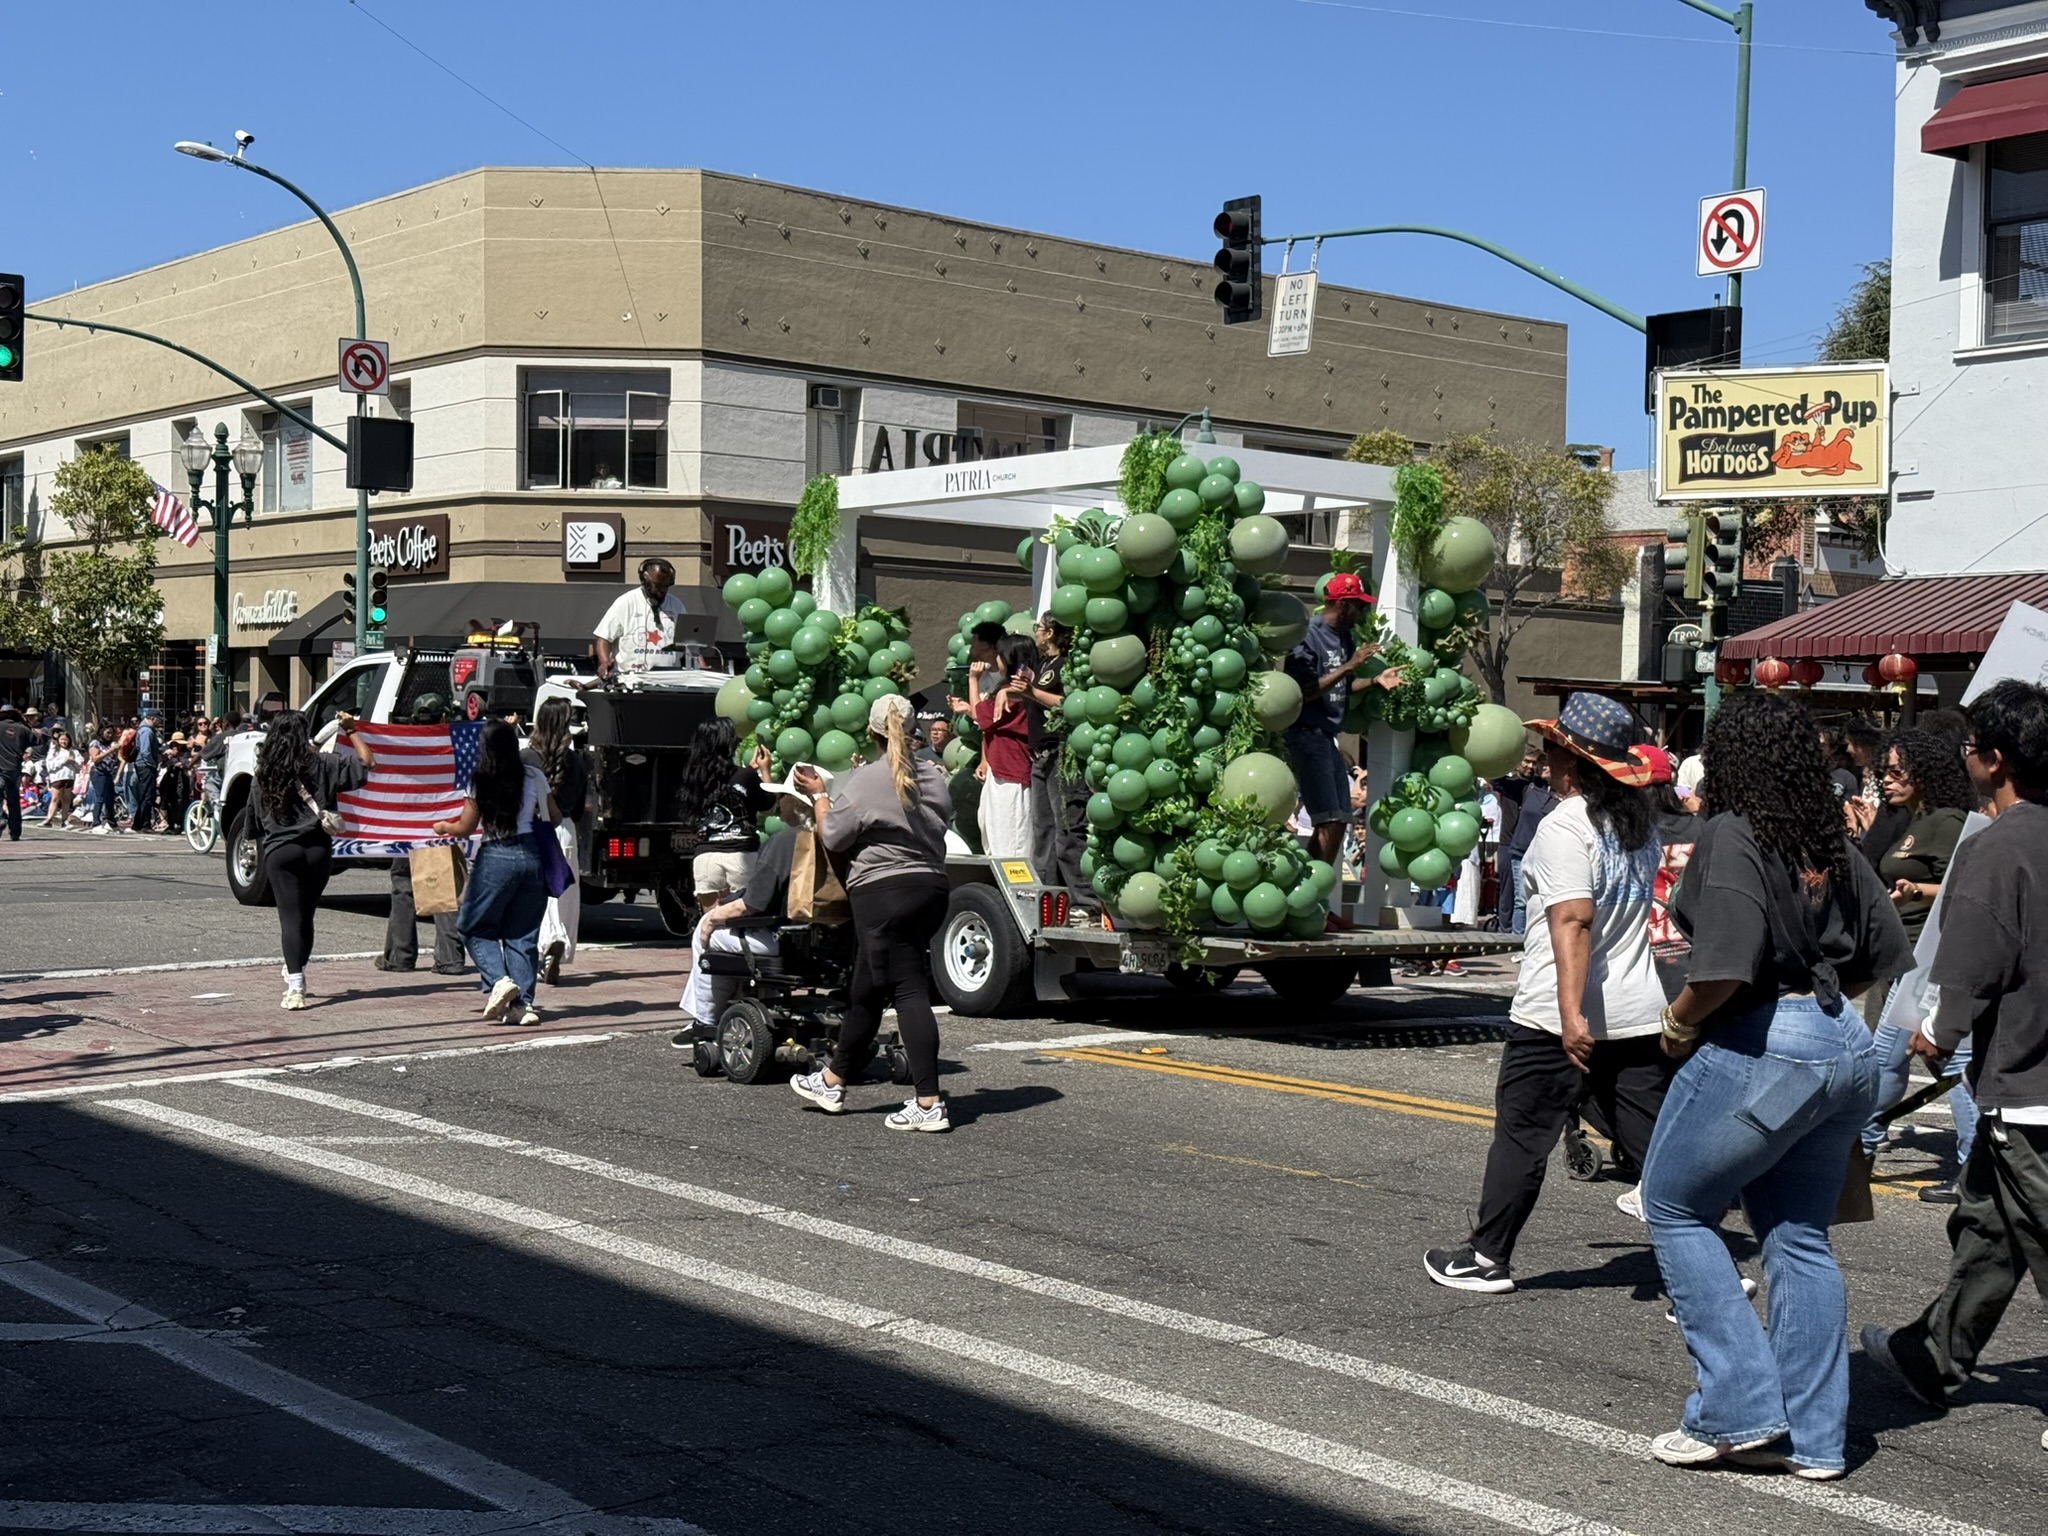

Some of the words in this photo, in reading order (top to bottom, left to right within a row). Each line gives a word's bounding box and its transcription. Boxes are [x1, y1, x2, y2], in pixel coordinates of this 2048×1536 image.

[1290, 279, 1303, 291] NO
[1282, 293, 1308, 306] LEFT
[1280, 309, 1307, 321] TURN
[1692, 384, 1722, 404] The
[1669, 393, 1808, 432] Pampered
[1824, 390, 1877, 427] Pup
[1701, 437, 1758, 453] Deluxe
[1687, 450, 1722, 475] HOT
[1723, 446, 1769, 475] DOGS
[945, 469, 991, 493] PATRIA
[992, 473, 1017, 482] CHURCH
[397, 524, 437, 569] Coffee
[724, 524, 784, 568] Peet's
